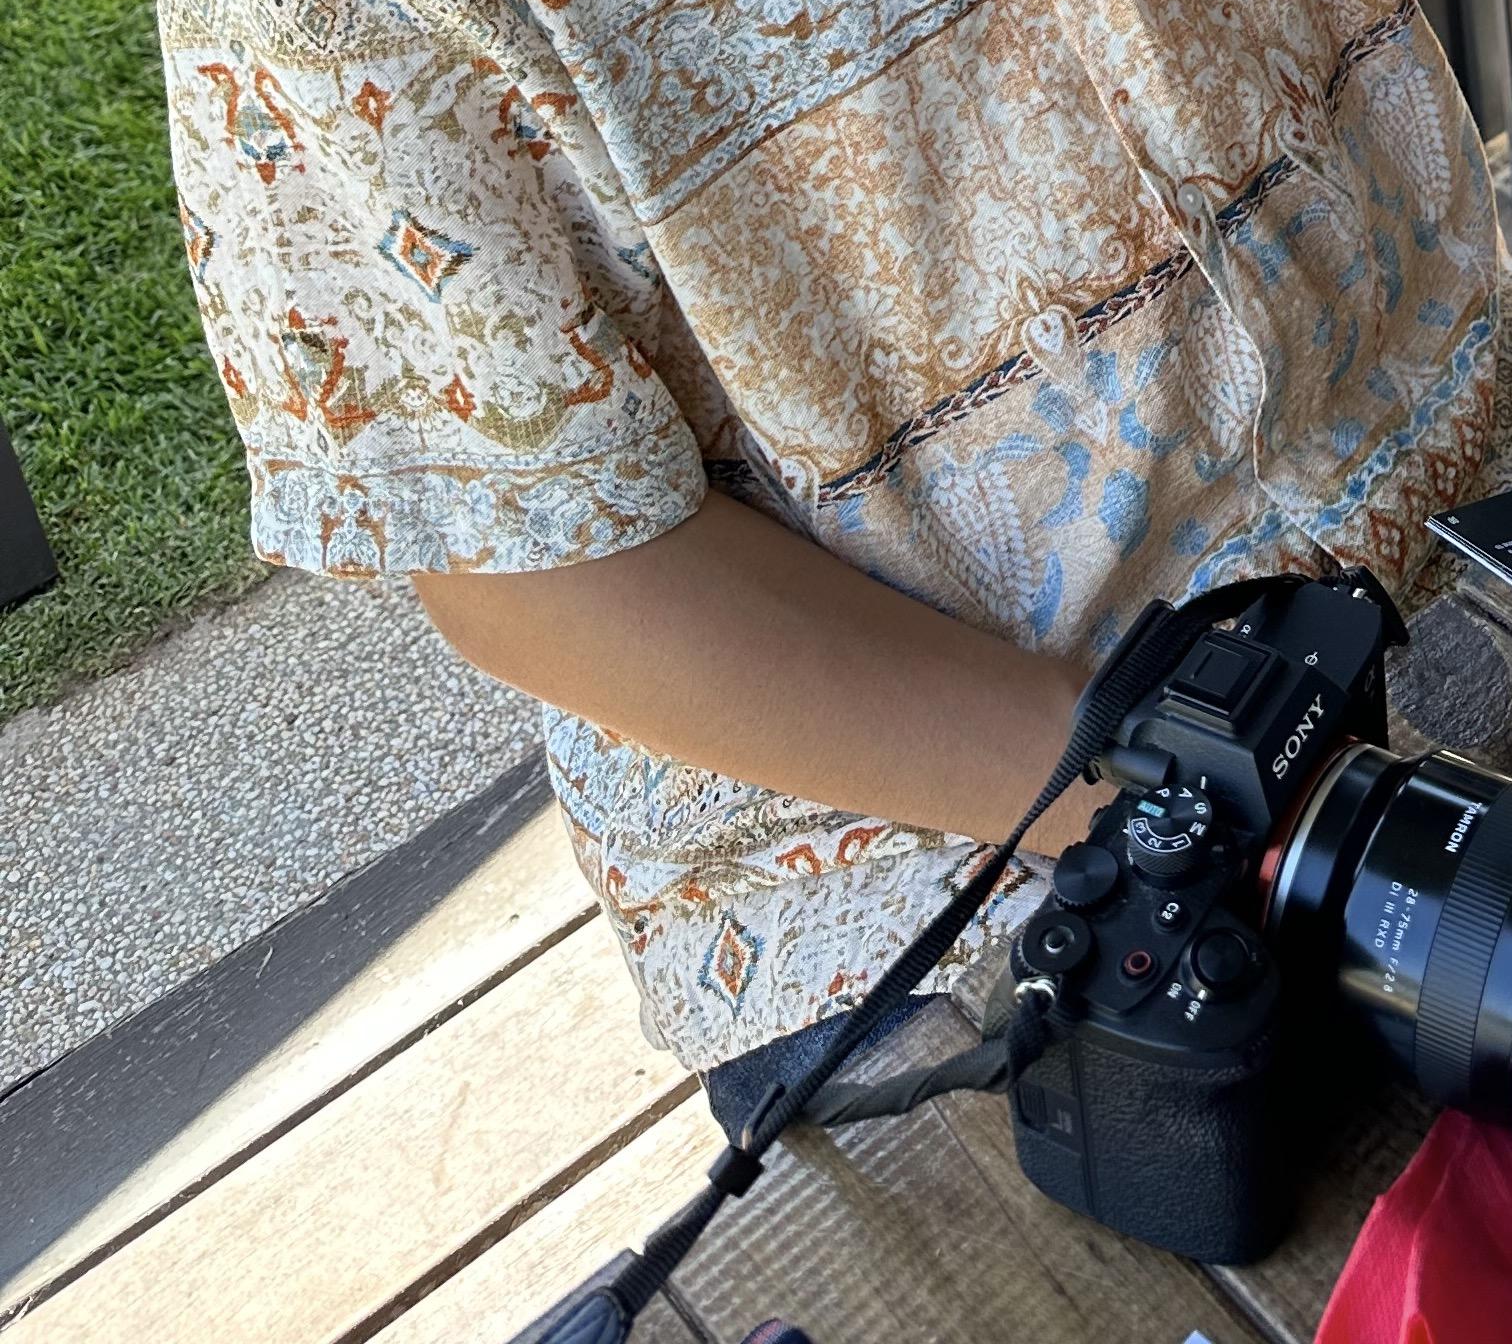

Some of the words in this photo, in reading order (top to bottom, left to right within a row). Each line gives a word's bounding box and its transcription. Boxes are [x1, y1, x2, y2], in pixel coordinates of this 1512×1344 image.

[1272, 694, 1324, 780] SONY
[1155, 788, 1170, 798] P
[1178, 787, 1193, 798] A
[1194, 802, 1207, 814] S
[1134, 821, 1146, 834] 3
[1189, 821, 1206, 836] M
[1445, 802, 1482, 853] TAMRON
[1147, 837, 1162, 848] 2
[1161, 902, 1179, 920] C2
[1384, 901, 1395, 914] III
[1392, 888, 1418, 951] 28-75mm
[1375, 919, 1390, 948] RXD
[1166, 982, 1182, 1000] ON
[1184, 1000, 1201, 1022] OFF
